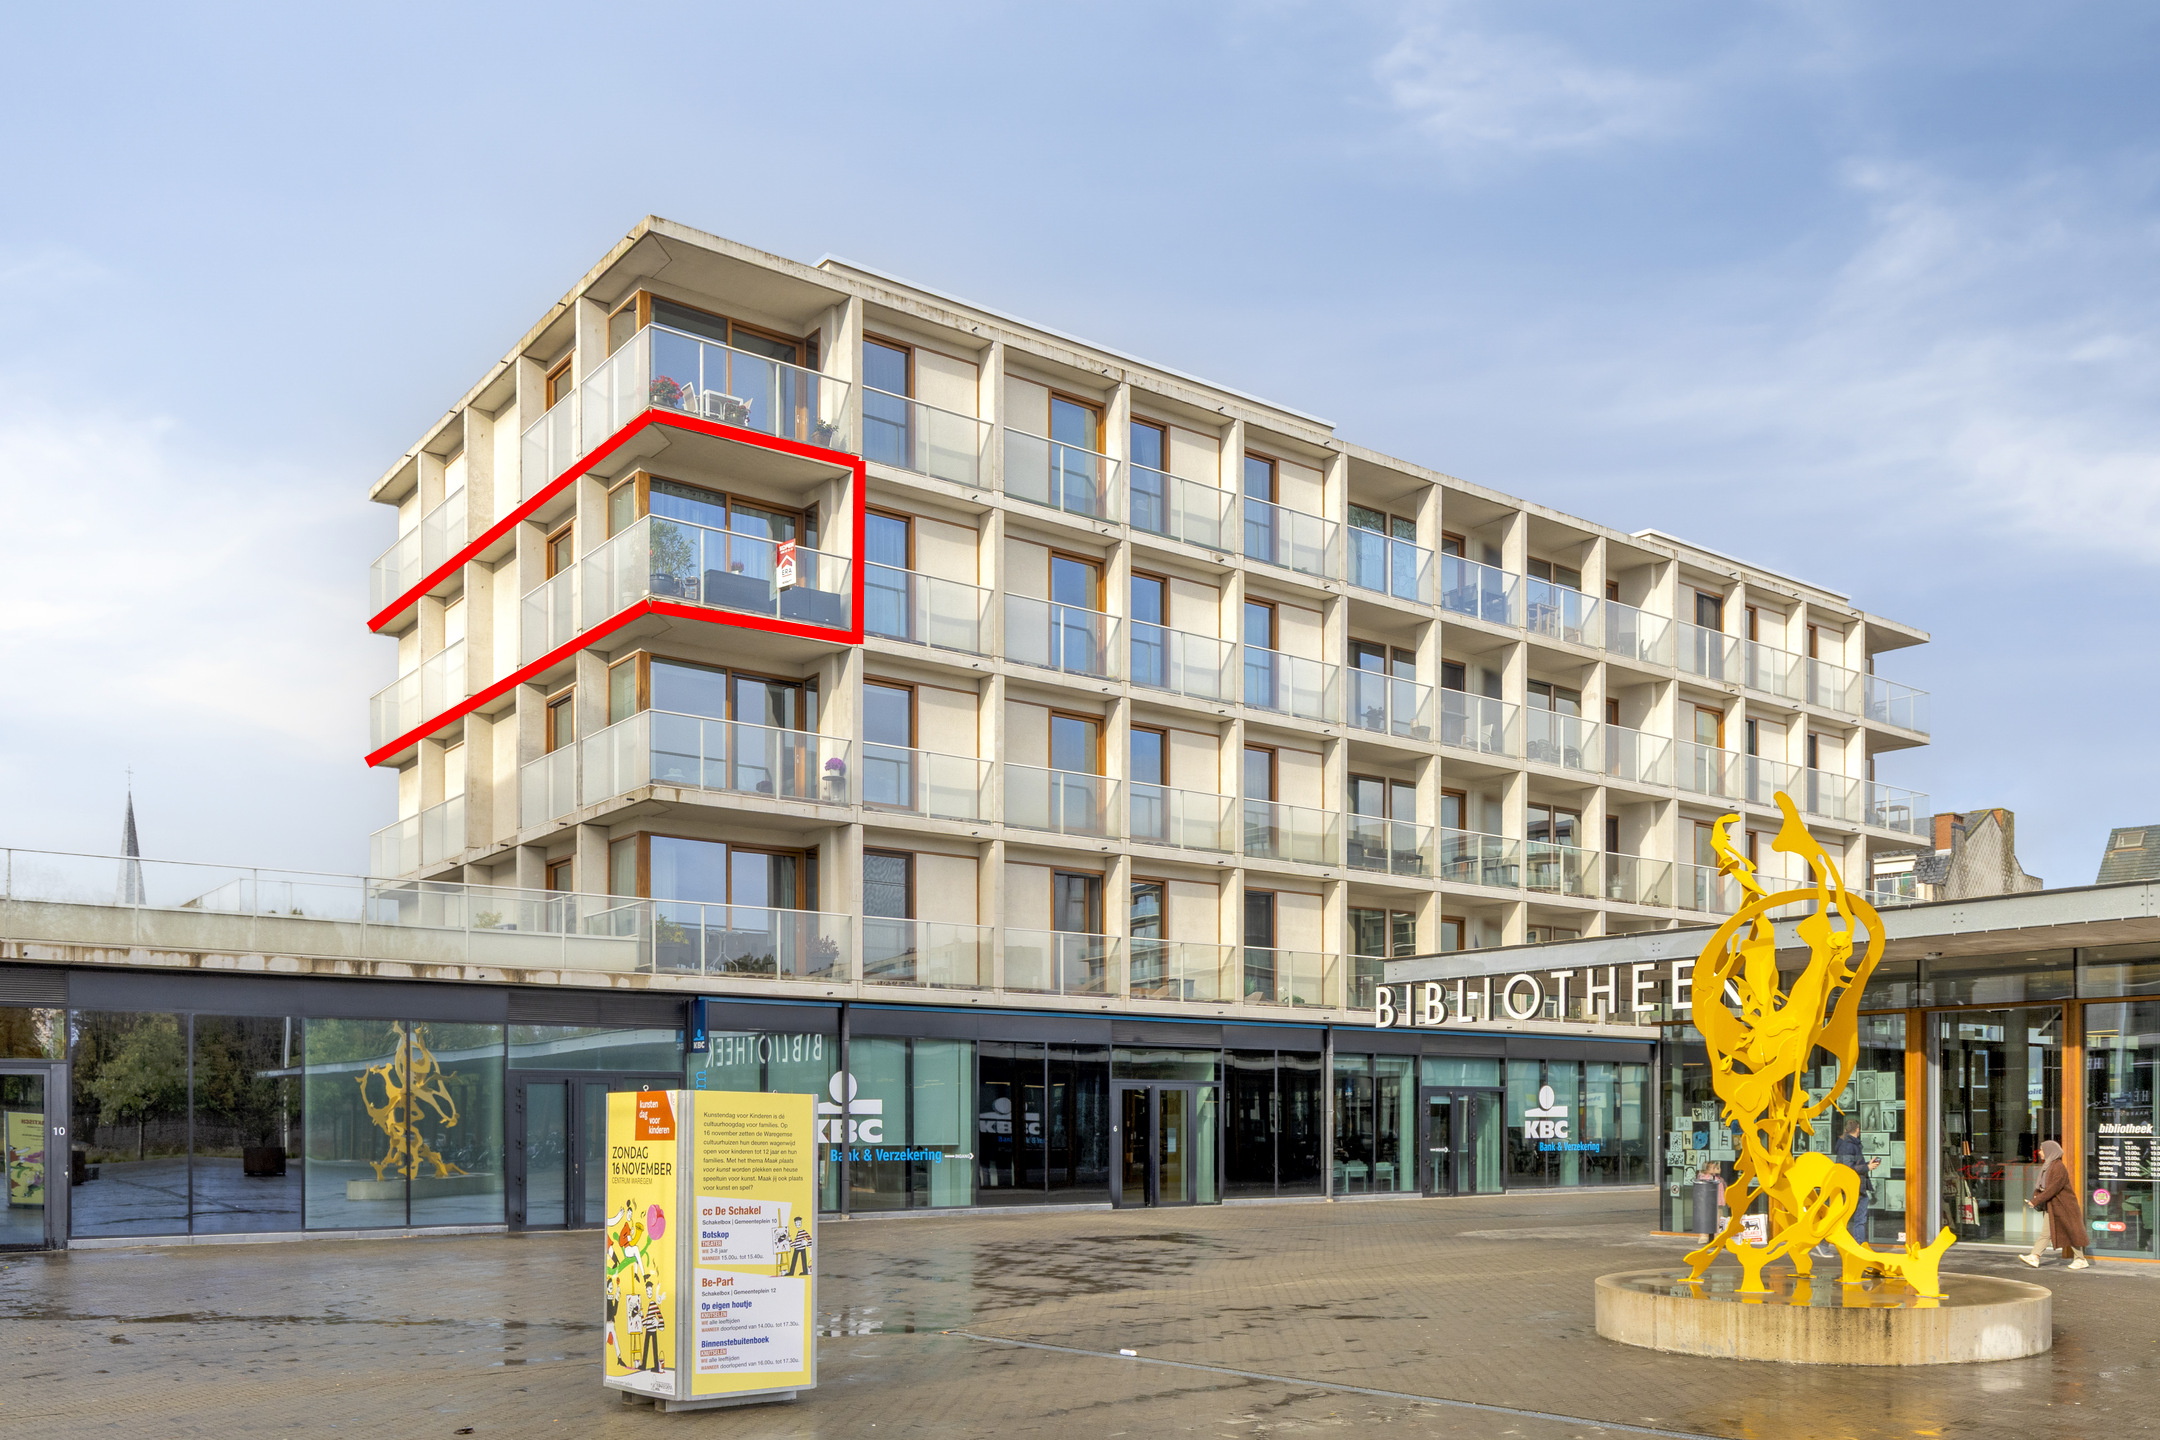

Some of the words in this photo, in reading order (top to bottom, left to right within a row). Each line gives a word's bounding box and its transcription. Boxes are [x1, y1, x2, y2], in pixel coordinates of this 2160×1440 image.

[782, 568, 792, 576] ERA
[1375, 959, 1743, 1028] BIBLIOTHEE
[694, 1041, 705, 1049] KBC
[640, 1100, 658, 1108] kunsten
[639, 1110, 648, 1120] dag
[53, 1126, 66, 1136] 10
[648, 1126, 670, 1134] kinderen
[1524, 1120, 1568, 1138] KBC
[2098, 1124, 2154, 1134] bibliotheek
[1539, 1142, 1556, 1152] Bank
[1557, 1142, 1562, 1152] &
[1564, 1141, 1600, 1152] Verzekering
[612, 1146, 648, 1159] ZONDAG
[864, 1149, 872, 1162] &
[876, 1148, 942, 1164] Verzekering
[612, 1162, 620, 1175] 16
[622, 1162, 672, 1176] NOVEMBER
[715, 1206, 726, 1216] De
[728, 1206, 762, 1216] Schakel
[702, 1231, 730, 1239] Botskop
[702, 1277, 734, 1287] Be-Part
[702, 1302, 710, 1311] Op
[712, 1302, 730, 1310] eigen
[732, 1300, 752, 1309] houtje
[702, 1336, 770, 1348] Binnenstebuitenboek
